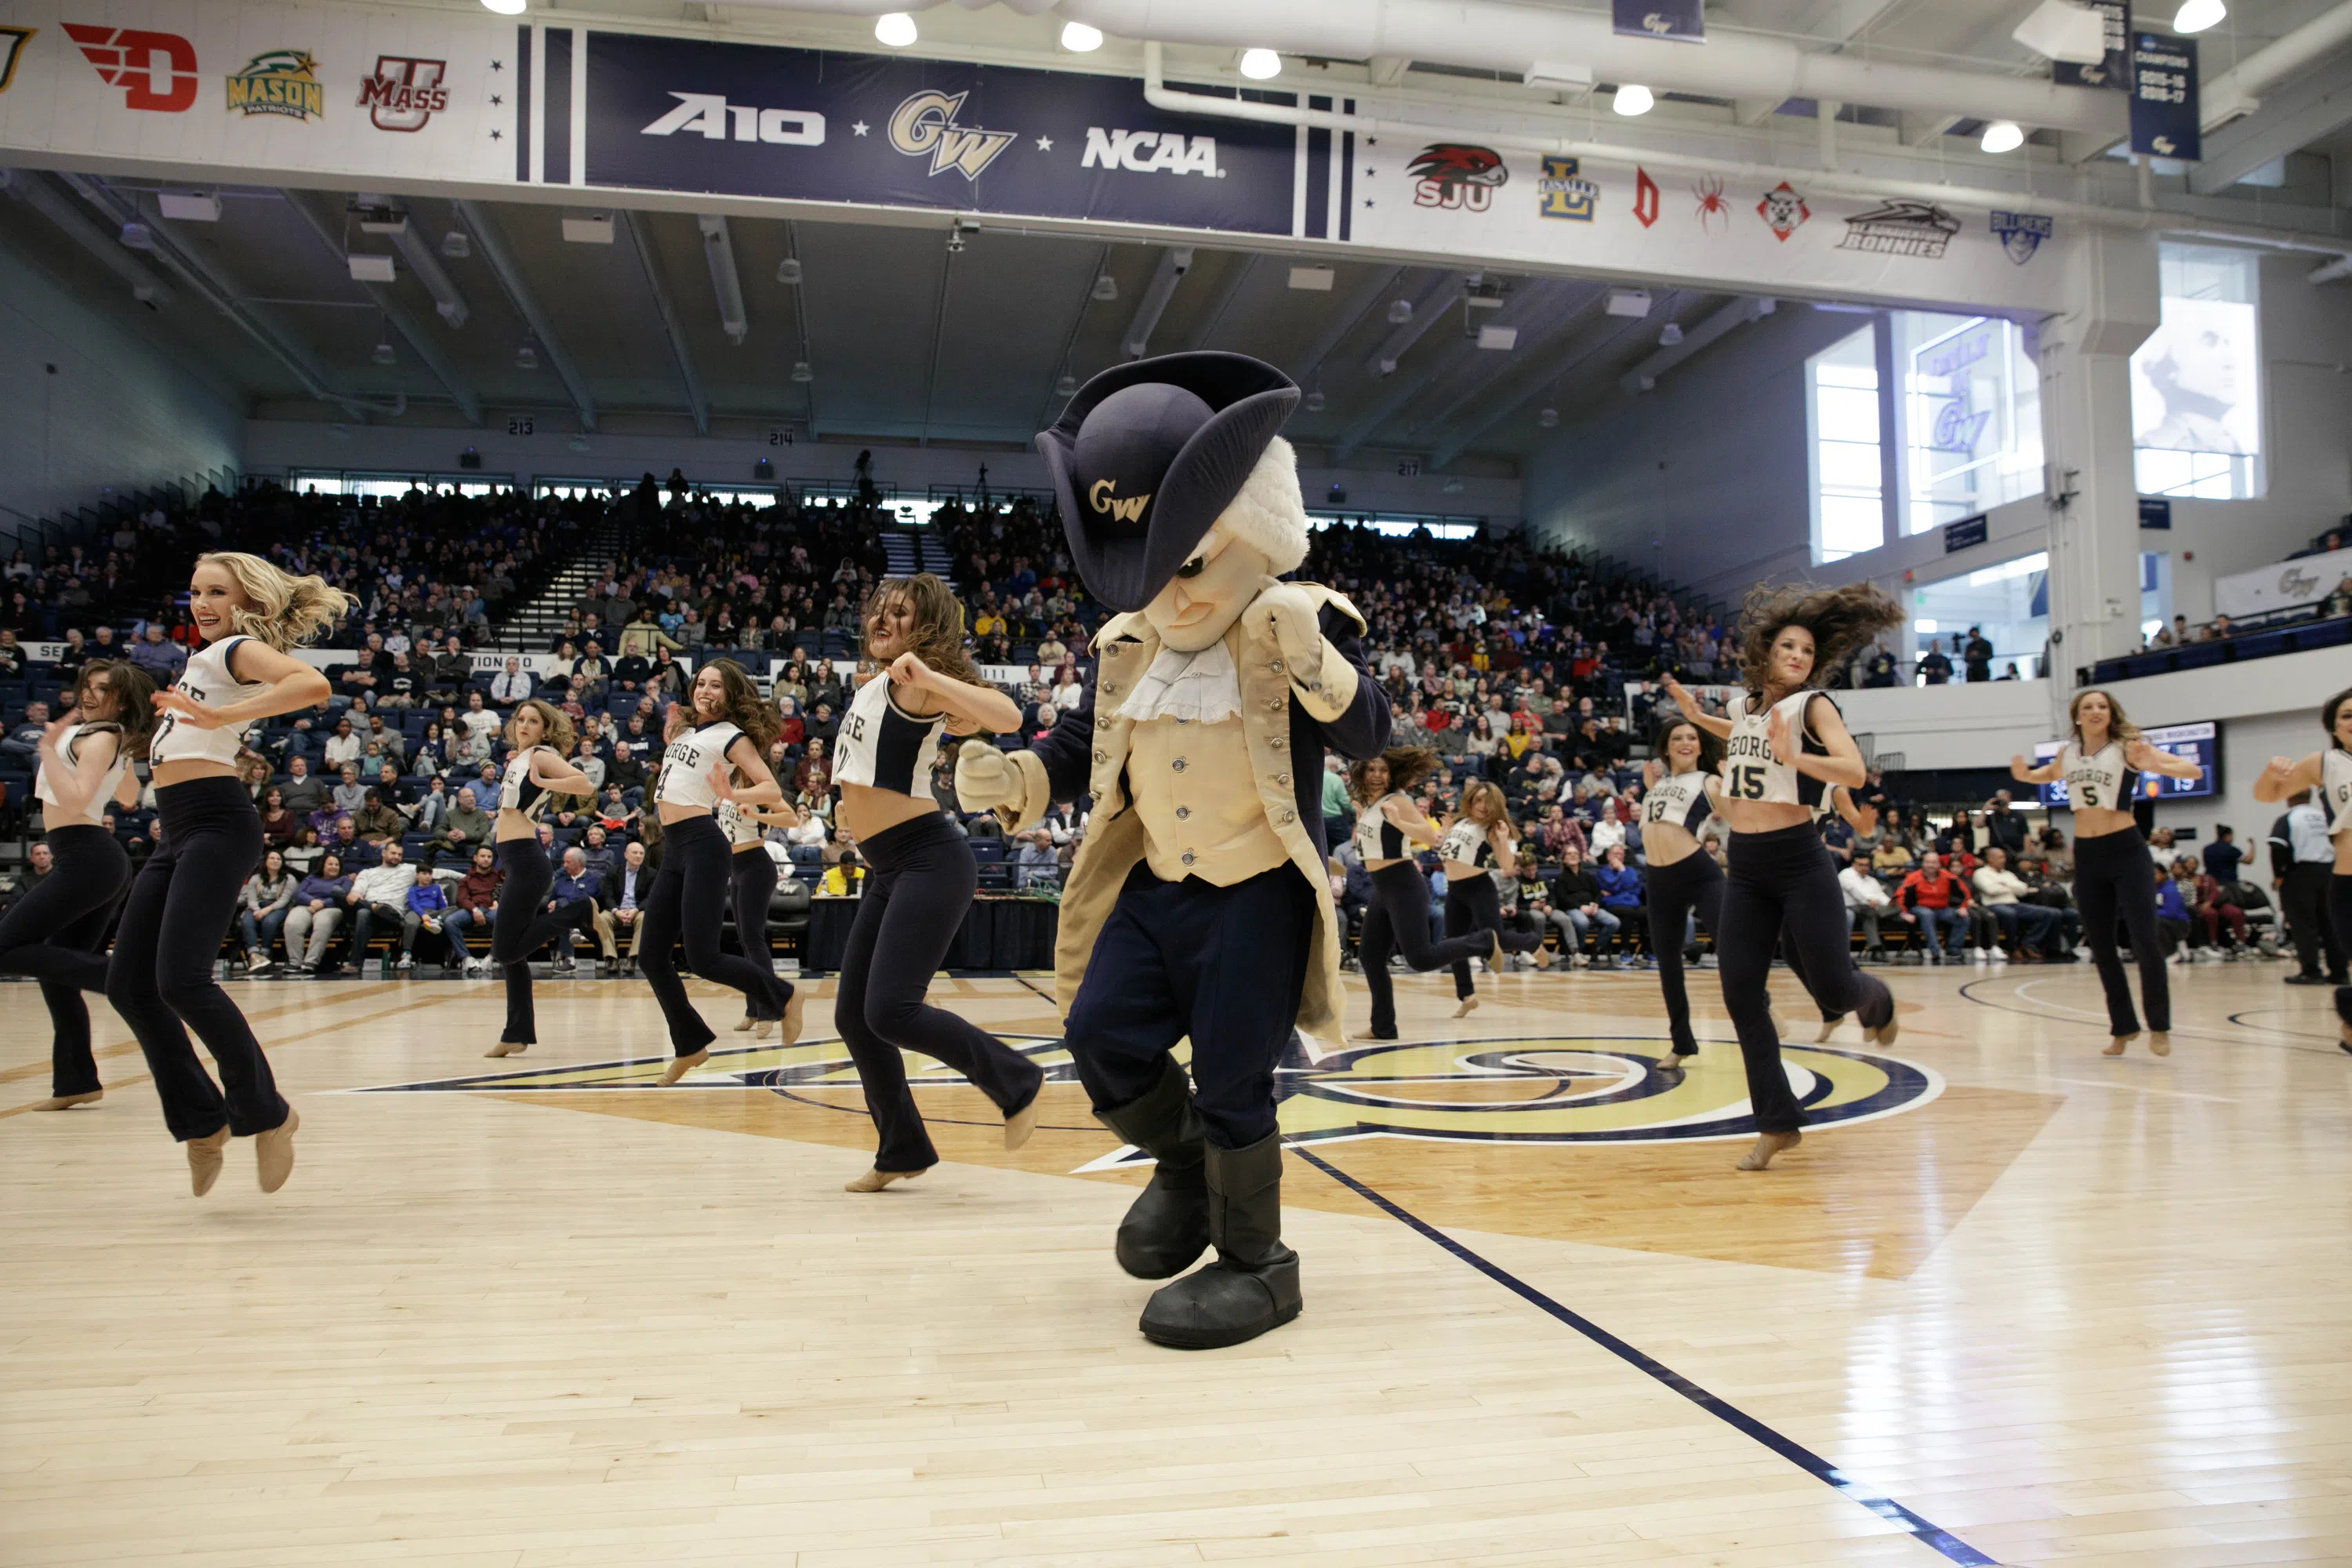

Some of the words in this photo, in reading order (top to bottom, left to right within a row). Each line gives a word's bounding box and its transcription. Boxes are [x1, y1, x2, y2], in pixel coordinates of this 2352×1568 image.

[227, 77, 322, 117] MASON
[358, 77, 448, 113] MASS
[247, 103, 304, 118] PATRIOTS
[640, 91, 826, 147] A10
[888, 89, 1018, 182] GW
[1414, 179, 1492, 212] SJU
[1843, 233, 1945, 258] BONNIES
[509, 422, 533, 435] 213
[1934, 397, 1991, 453] GW
[770, 433, 793, 446] 214
[1398, 463, 1418, 477] 217
[1089, 478, 1152, 524] GW
[665, 742, 701, 768] ORGE
[1730, 764, 1766, 800] 15
[2082, 786, 2099, 806] 5
[1648, 800, 1668, 822] 13
[1440, 842, 1461, 859] 24
[775, 878, 800, 895] GW
